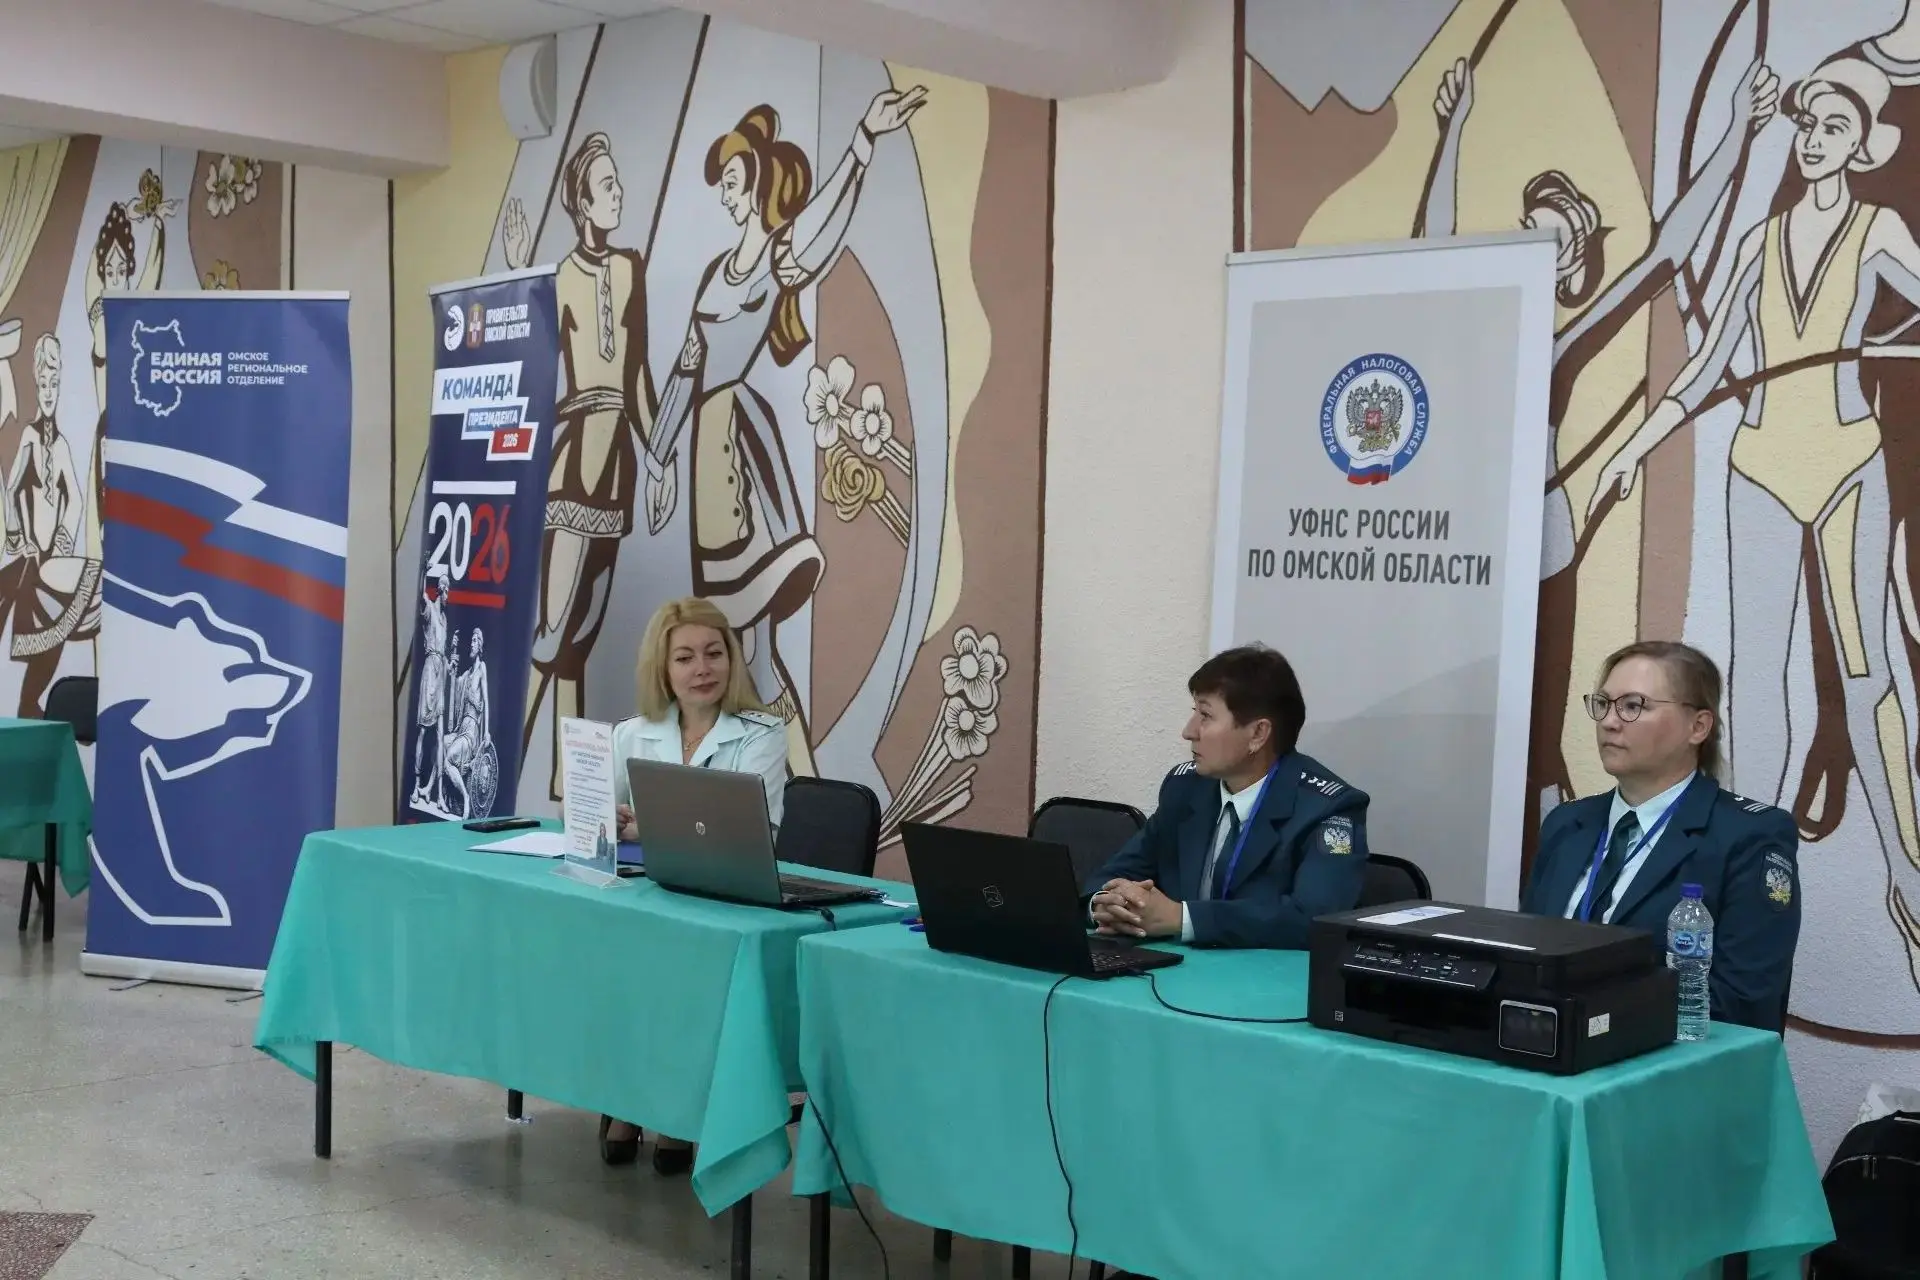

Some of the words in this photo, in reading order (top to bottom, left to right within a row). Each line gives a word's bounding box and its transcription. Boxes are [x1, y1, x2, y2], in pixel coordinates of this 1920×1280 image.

[150, 351, 222, 368] ЕДИНАЯ
[227, 352, 269, 362] ОМСКОЕ
[150, 369, 222, 384] РОССИЯ
[227, 363, 308, 374] РЕГИОНАЛЬНОЕ
[227, 375, 285, 386] ОТДЕЛЕНИЕ
[442, 373, 513, 401] КОМАНДА
[1323, 367, 1356, 454] ФЕДЕРАЛЬНАЯ
[1361, 358, 1422, 395] НАЛОГОВАЯ
[1404, 402, 1426, 455] СЛУЖБА
[468, 409, 518, 428] ПРЕЗИДЕНТА
[1288, 508, 1349, 538] УФНС
[1356, 509, 1450, 540] РОССИИ
[426, 501, 511, 585] 2026
[1247, 548, 1275, 578] ПО
[1282, 546, 1376, 581] ОМСКОЙ
[1383, 552, 1491, 586] ОБЛАСТИ
